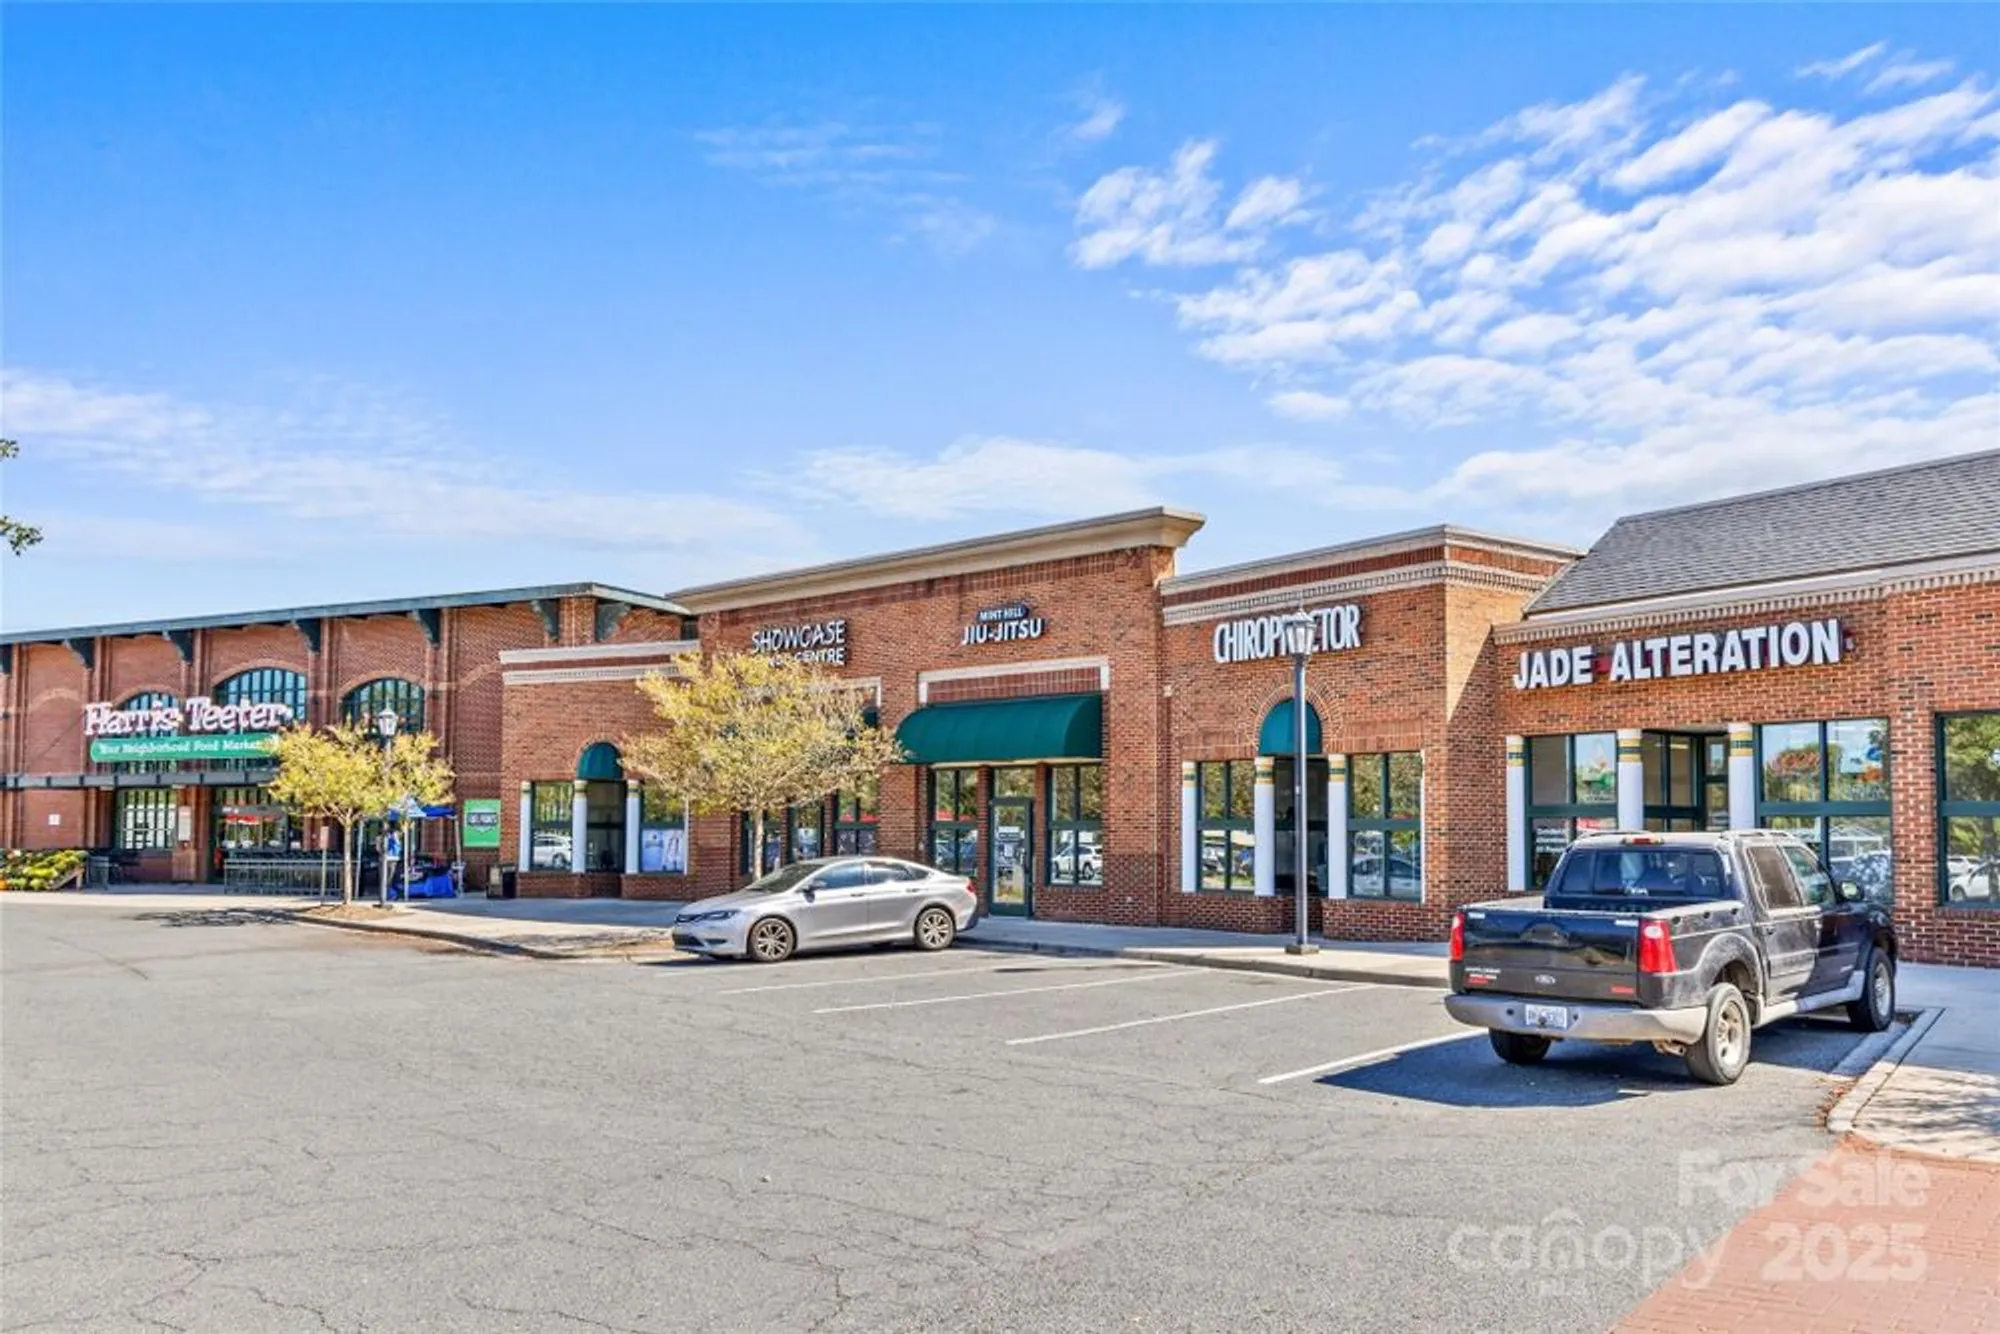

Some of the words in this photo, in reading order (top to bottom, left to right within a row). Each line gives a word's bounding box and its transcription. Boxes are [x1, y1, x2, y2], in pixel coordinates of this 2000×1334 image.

[961, 618, 1042, 645] JIU-JITSU
[980, 610, 1002, 621] MINT
[1004, 607, 1024, 619] HILL
[751, 619, 846, 653] SHOWCASE
[1213, 604, 1361, 663] CHIROPRCTOR
[1512, 645, 1594, 690] JADE
[1609, 618, 1840, 682] ALTERATION
[84, 701, 180, 736] Harris
[185, 695, 293, 731] Teeter
